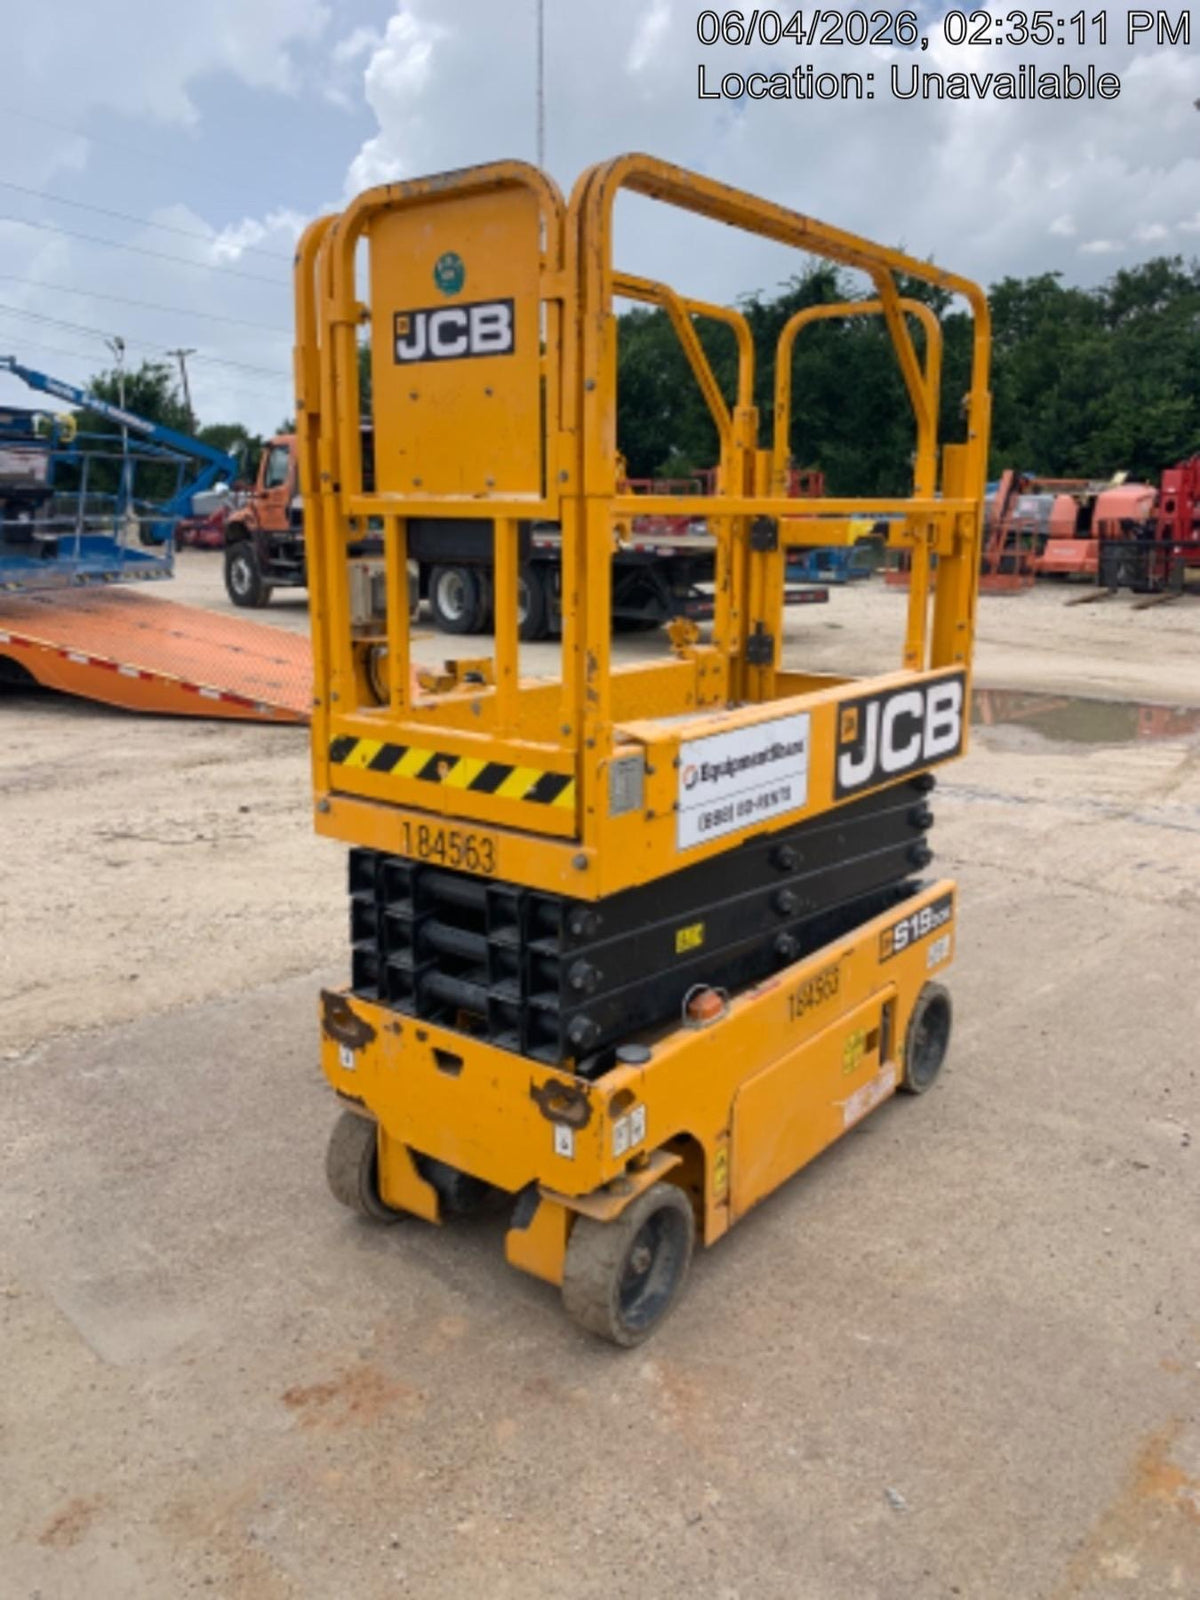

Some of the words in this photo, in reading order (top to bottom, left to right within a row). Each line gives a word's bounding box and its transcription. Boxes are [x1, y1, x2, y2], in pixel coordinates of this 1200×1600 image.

[396, 303, 512, 360] JCB
[838, 681, 963, 789] JCB
[402, 821, 496, 874] 184563
